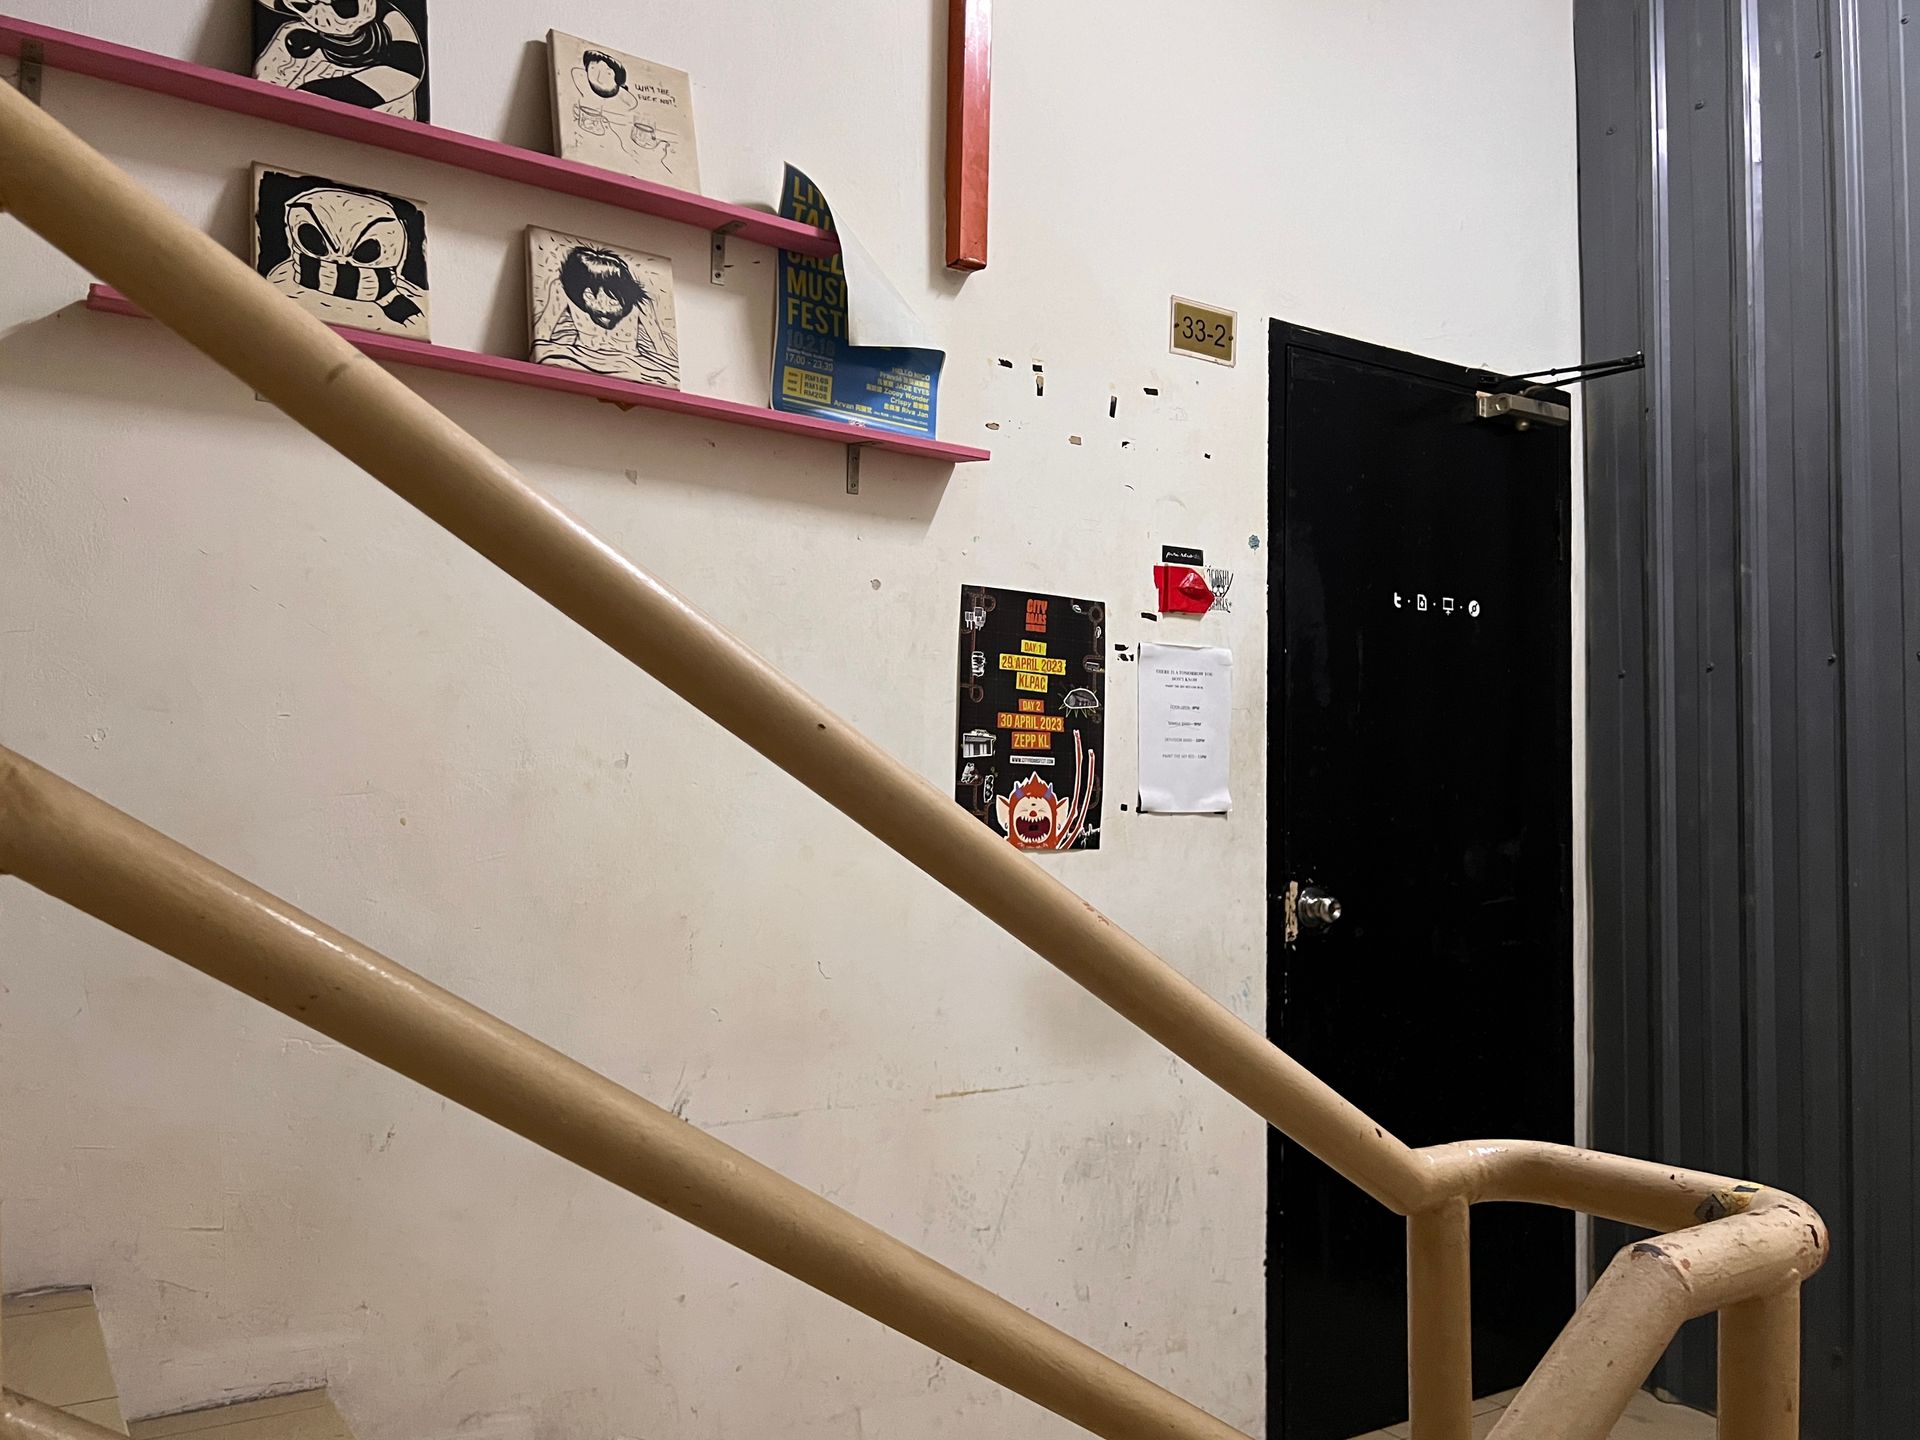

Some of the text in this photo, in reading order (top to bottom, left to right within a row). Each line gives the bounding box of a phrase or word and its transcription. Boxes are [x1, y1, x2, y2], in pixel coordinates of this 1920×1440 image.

[635, 83, 655, 93] WHY
[1182, 316, 1226, 348] 33-2
[1027, 598, 1048, 614] CITY
[1025, 642, 1036, 653] DAY
[1002, 655, 1063, 673] 29 APRIL 2023
[1018, 673, 1046, 690] KLPAC
[1022, 700, 1034, 711] DAY
[1000, 713, 1062, 731] 30 APRIL 2023
[1014, 733, 1049, 749] ZEPP KL
